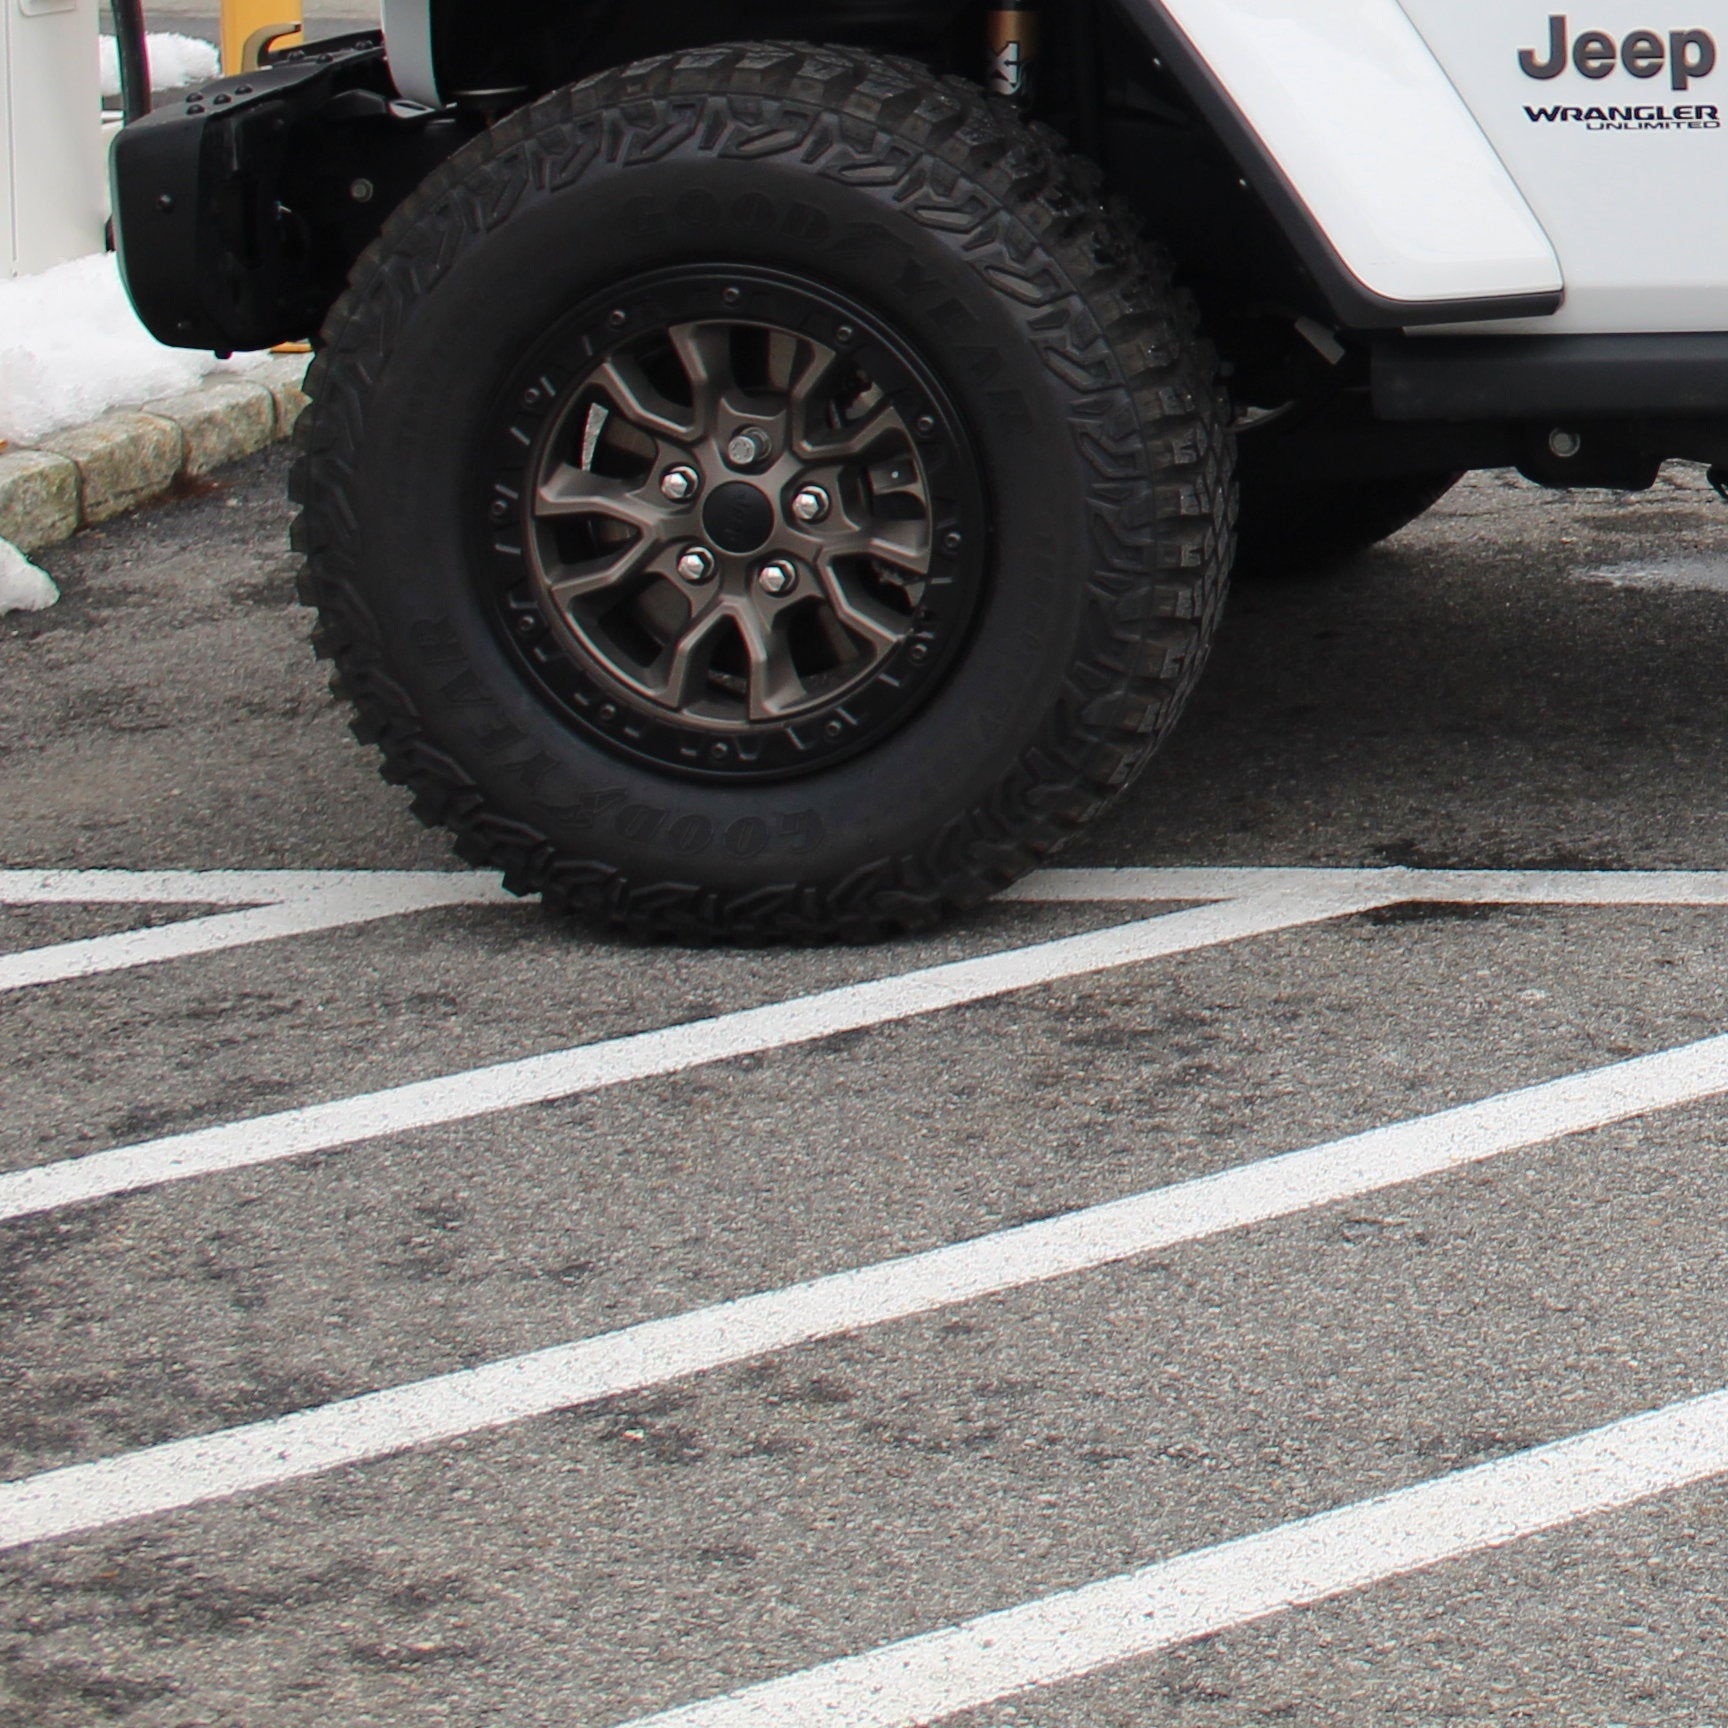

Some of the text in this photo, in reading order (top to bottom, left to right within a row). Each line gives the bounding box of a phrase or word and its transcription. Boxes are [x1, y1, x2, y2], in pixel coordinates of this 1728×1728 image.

[1517, 14, 1717, 91] Jeep
[1522, 105, 1720, 122] WRANGLER
[1586, 121, 1722, 131] UNLIMITED
